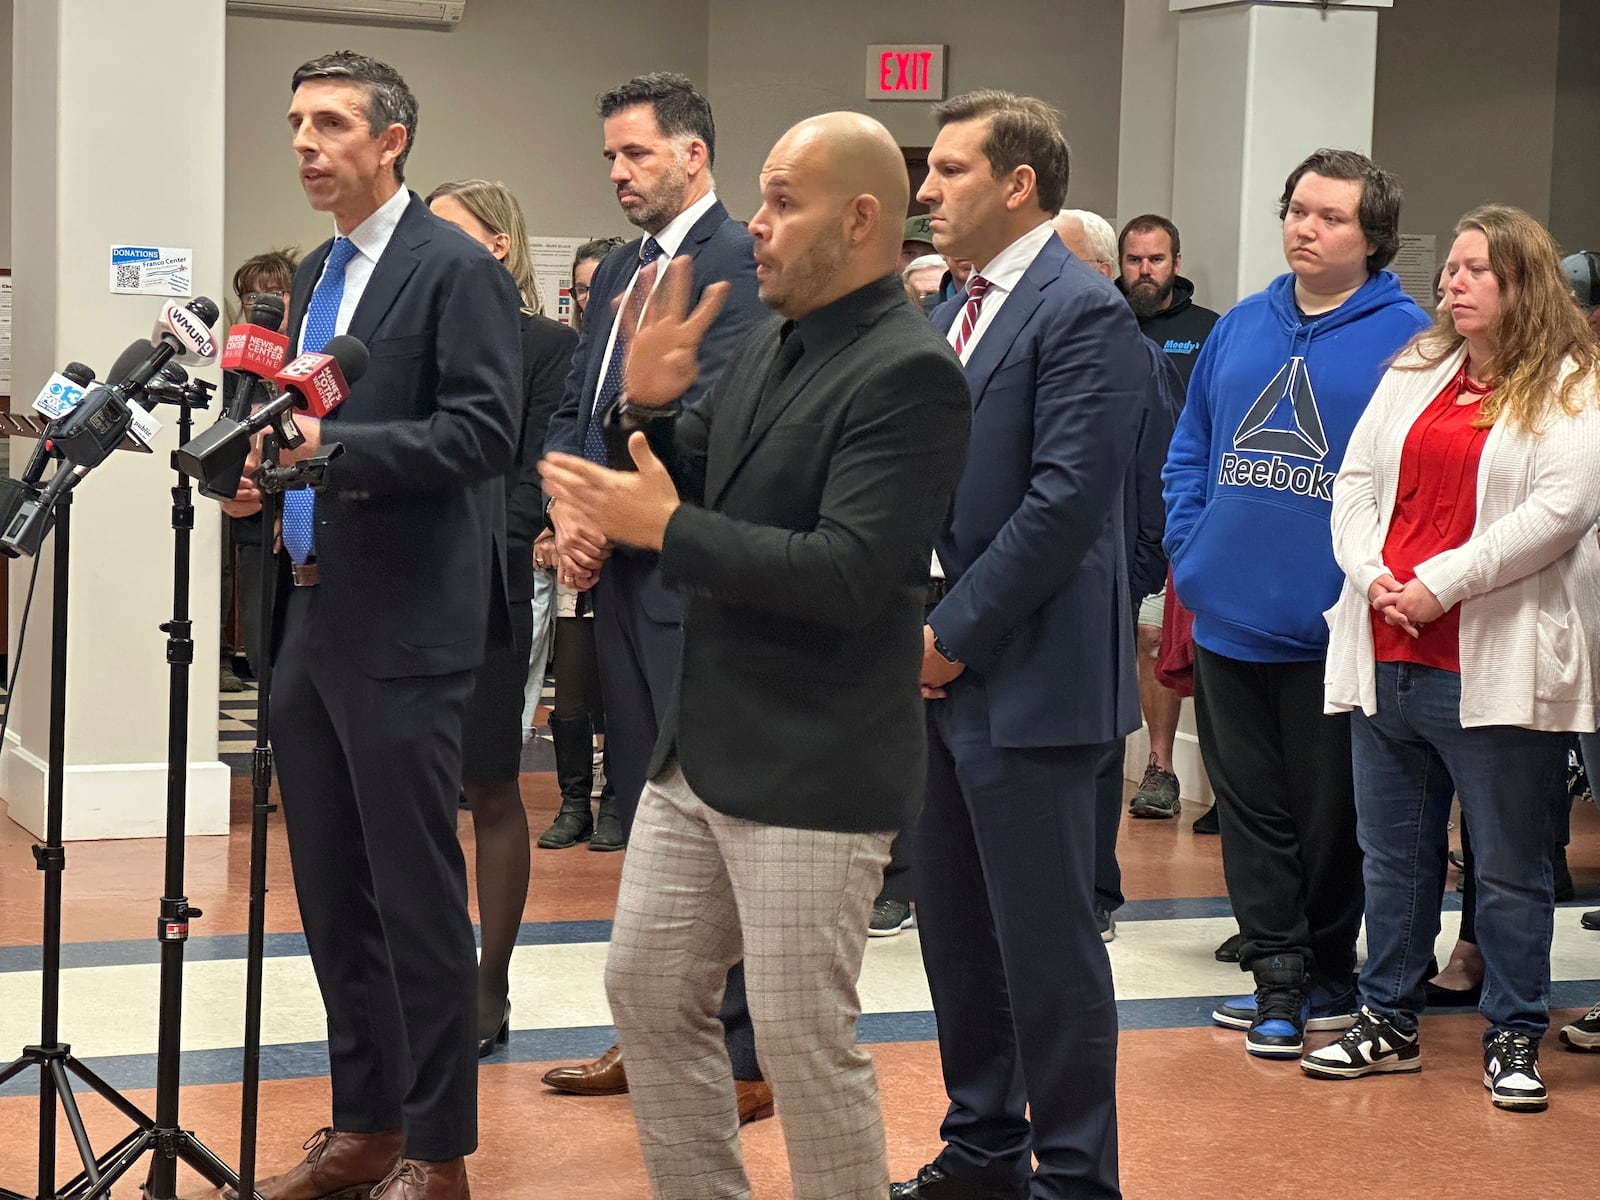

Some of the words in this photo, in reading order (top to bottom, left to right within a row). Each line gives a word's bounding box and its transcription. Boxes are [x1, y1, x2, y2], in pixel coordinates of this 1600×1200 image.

[880, 51, 933, 91] EXIT
[113, 249, 158, 258] DONATIONS
[165, 257, 187, 265] Center
[172, 309, 205, 347] WMUR
[200, 342, 214, 356] 9
[247, 343, 283, 360] CENTER
[249, 335, 274, 350] NEWS
[1163, 339, 1200, 352] Moody's
[247, 351, 279, 369] MAINE
[312, 375, 331, 410] WEATHER
[318, 370, 333, 407] TOTAL
[324, 366, 342, 401] MAINE'S
[41, 392, 61, 410] FOX
[60, 385, 83, 408] 13
[133, 421, 152, 437] public
[1218, 453, 1337, 501] Reebok
